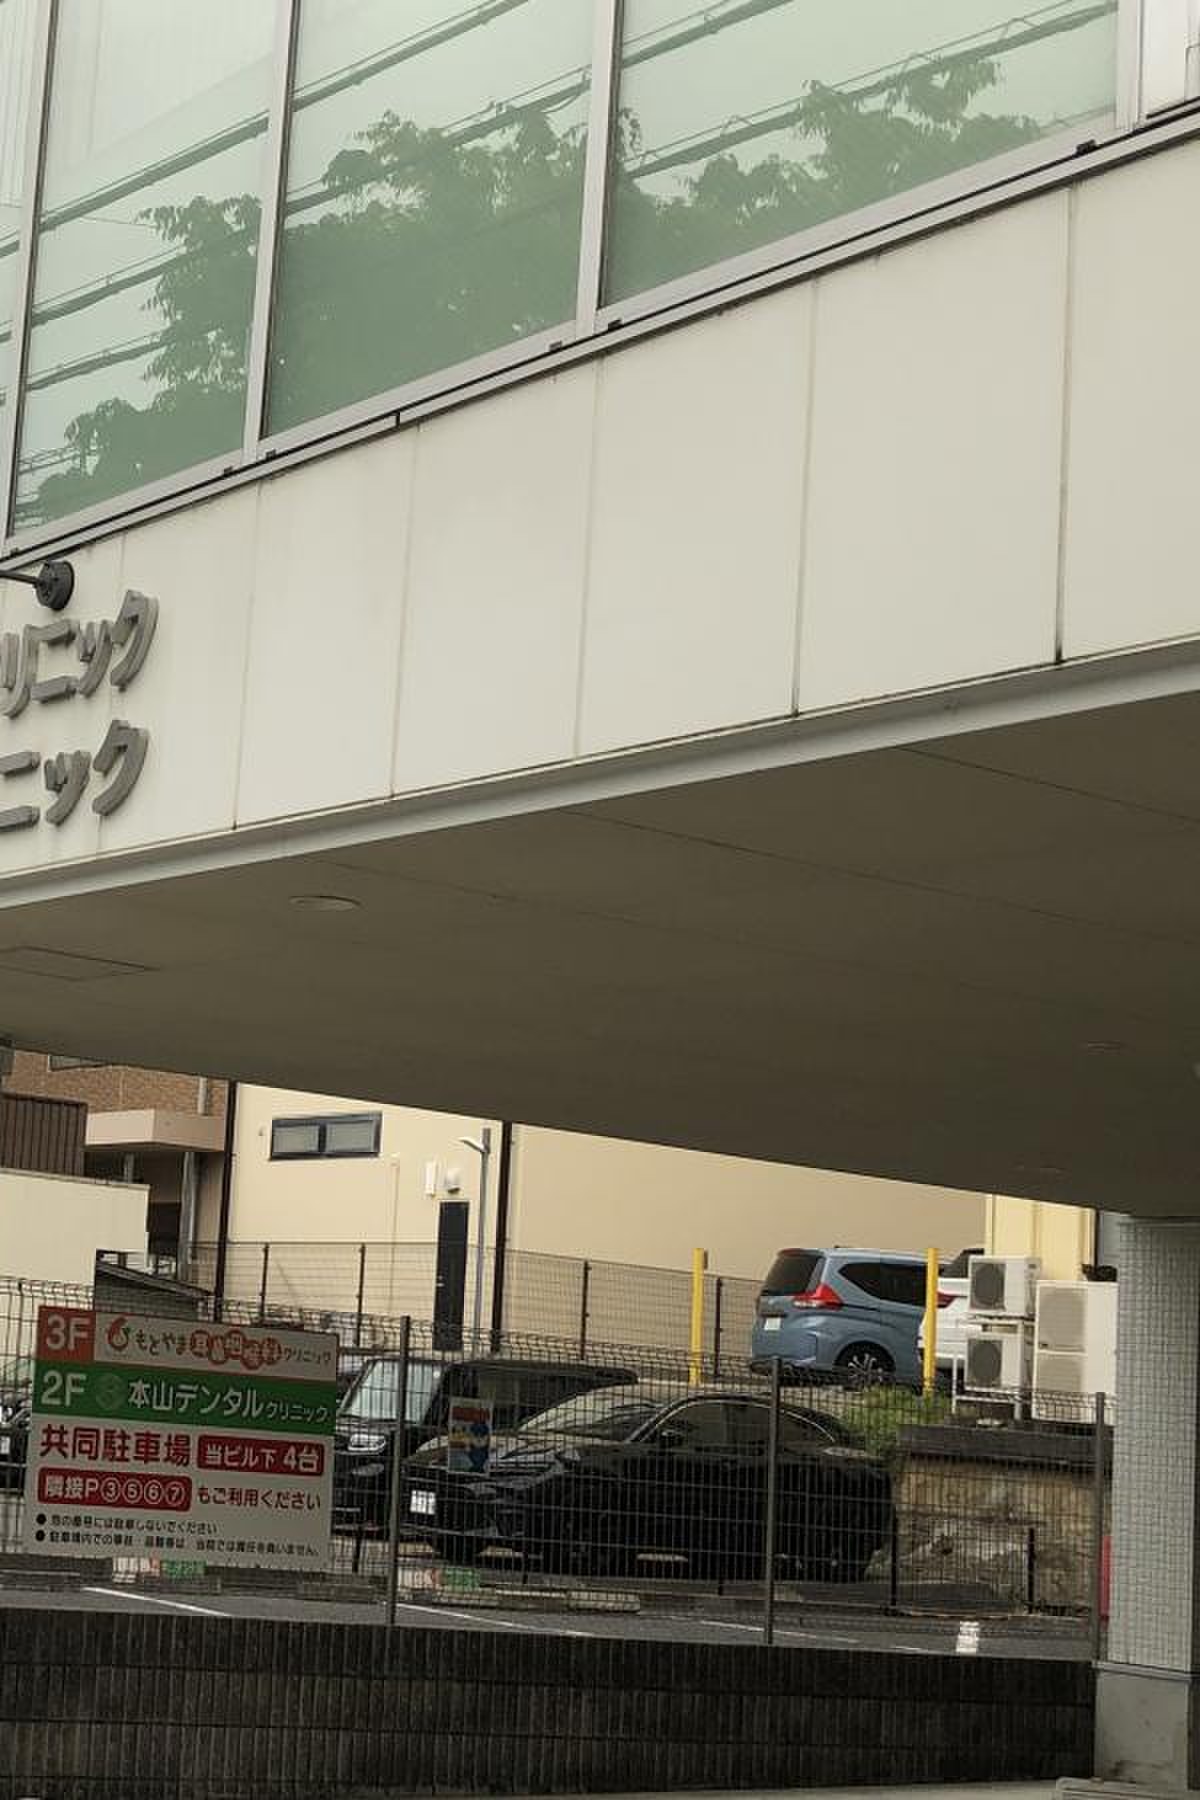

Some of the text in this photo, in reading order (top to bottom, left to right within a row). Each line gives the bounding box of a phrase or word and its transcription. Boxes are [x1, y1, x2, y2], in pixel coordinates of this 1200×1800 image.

[47, 1314, 92, 1352] 3F
[41, 1370, 87, 1406] 2F
[128, 1378, 329, 1422] 本山デンタルクリニック
[40, 1424, 191, 1467] 共同駐車場
[198, 1486, 321, 1511] もご利用ください
